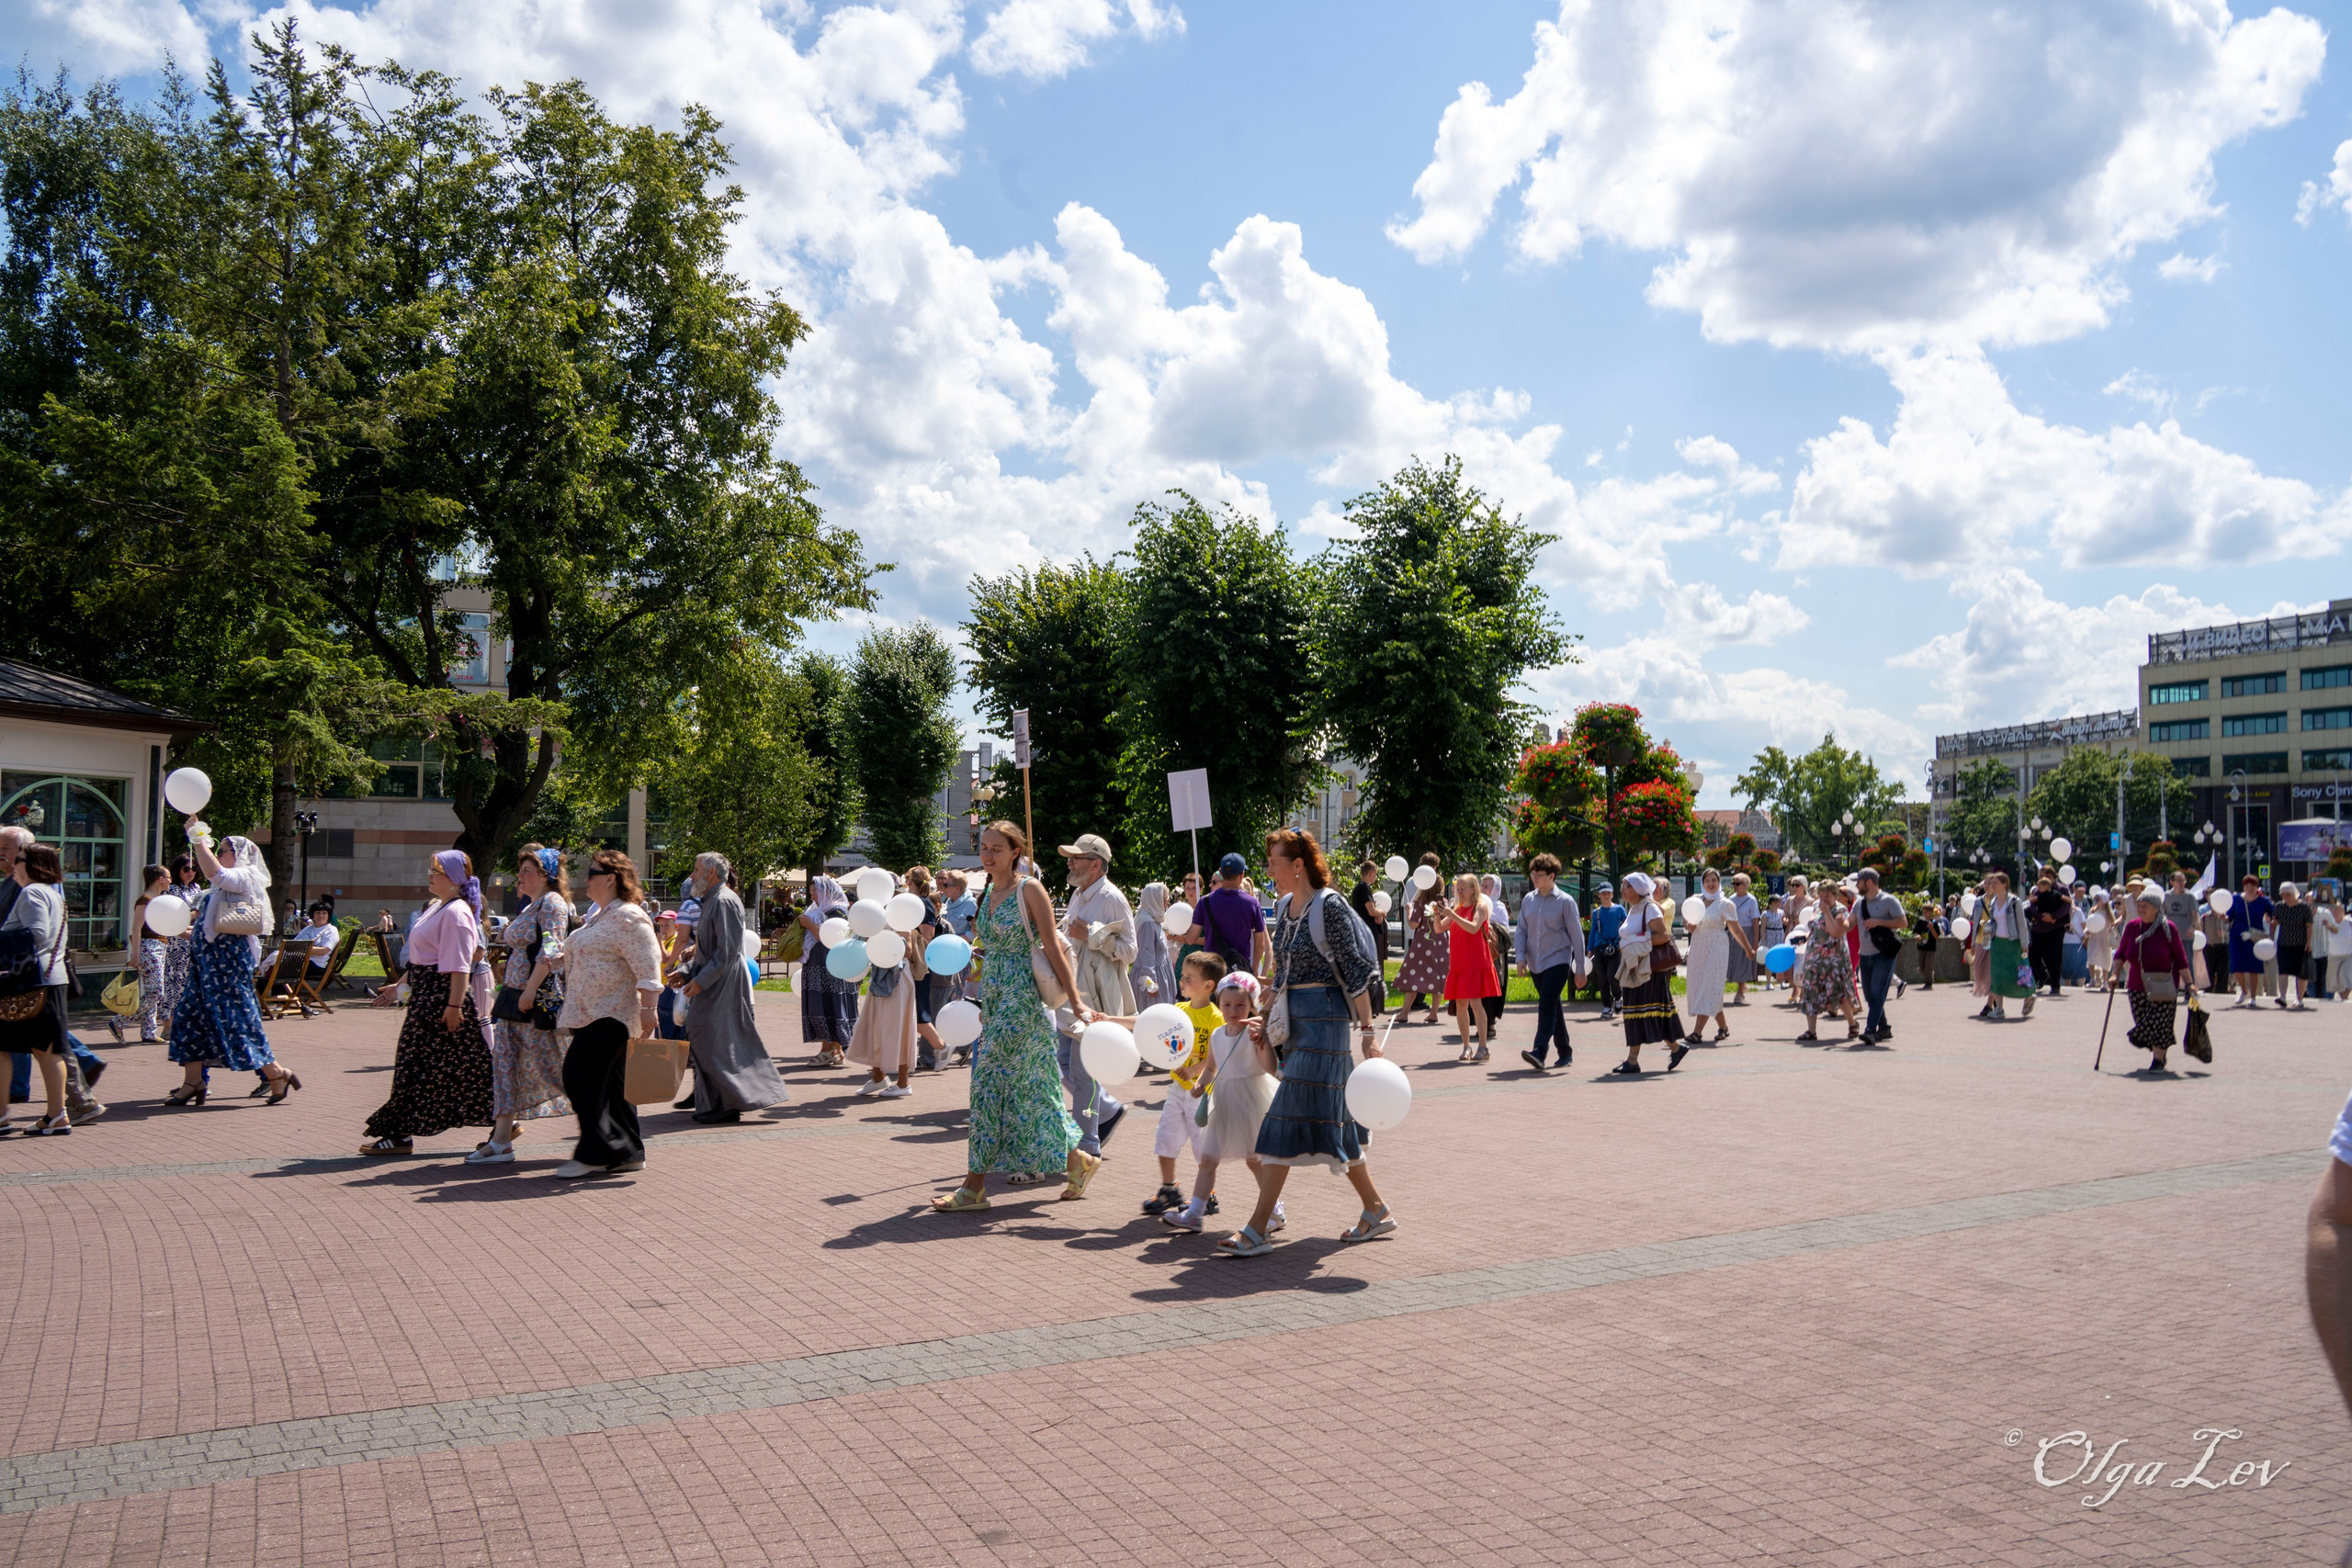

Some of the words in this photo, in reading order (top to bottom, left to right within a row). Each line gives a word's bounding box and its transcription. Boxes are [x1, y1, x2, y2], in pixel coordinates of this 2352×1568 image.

[1942, 739, 1965, 752] MAAG
[2292, 785, 2323, 800] Sony
[1158, 1022, 1184, 1041] ПАРАД
